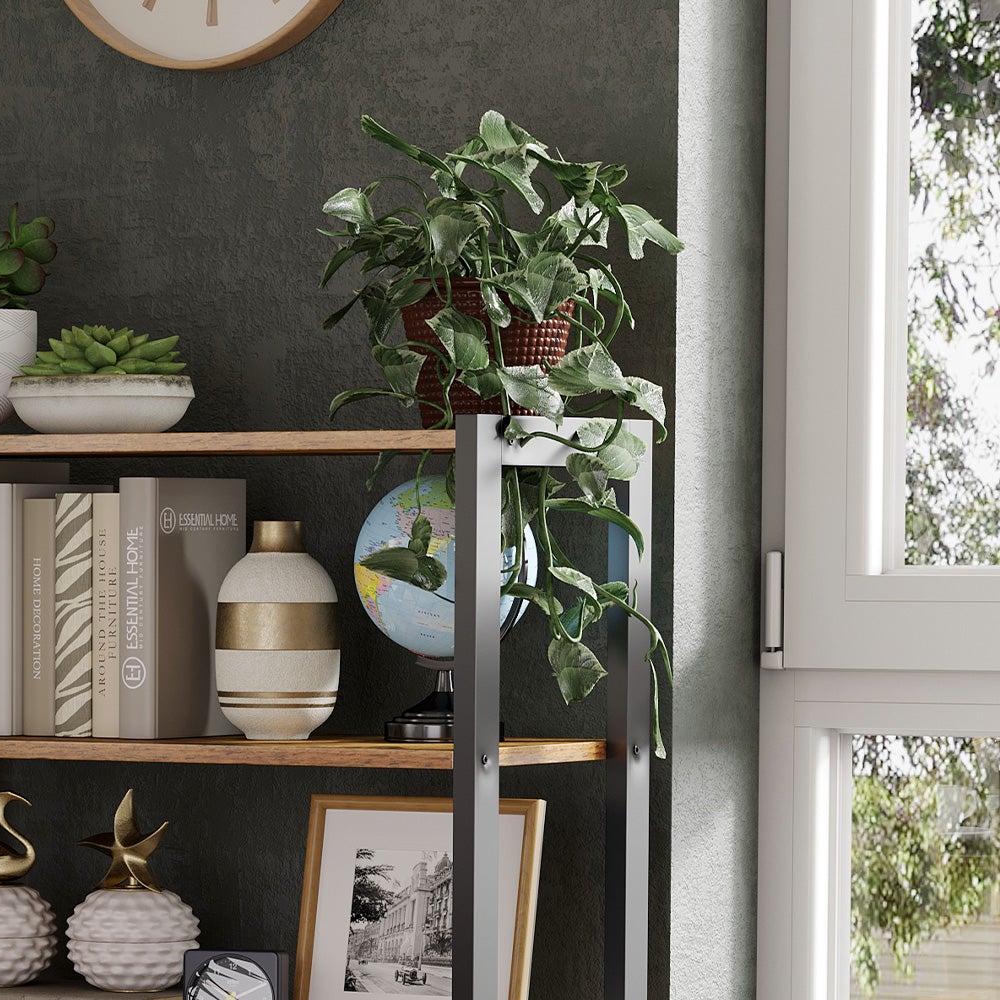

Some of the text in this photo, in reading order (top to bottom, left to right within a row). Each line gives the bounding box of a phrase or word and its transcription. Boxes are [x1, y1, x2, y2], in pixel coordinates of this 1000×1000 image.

[179, 513, 238, 526] ESSENTIAL HOME
[32, 558, 42, 680] HOME DECORATION
[98, 528, 107, 697] AROUND THE HOUSE
[108, 566, 117, 659] FURNITURE
[126, 527, 139, 650] ESSENTIAL HOME
